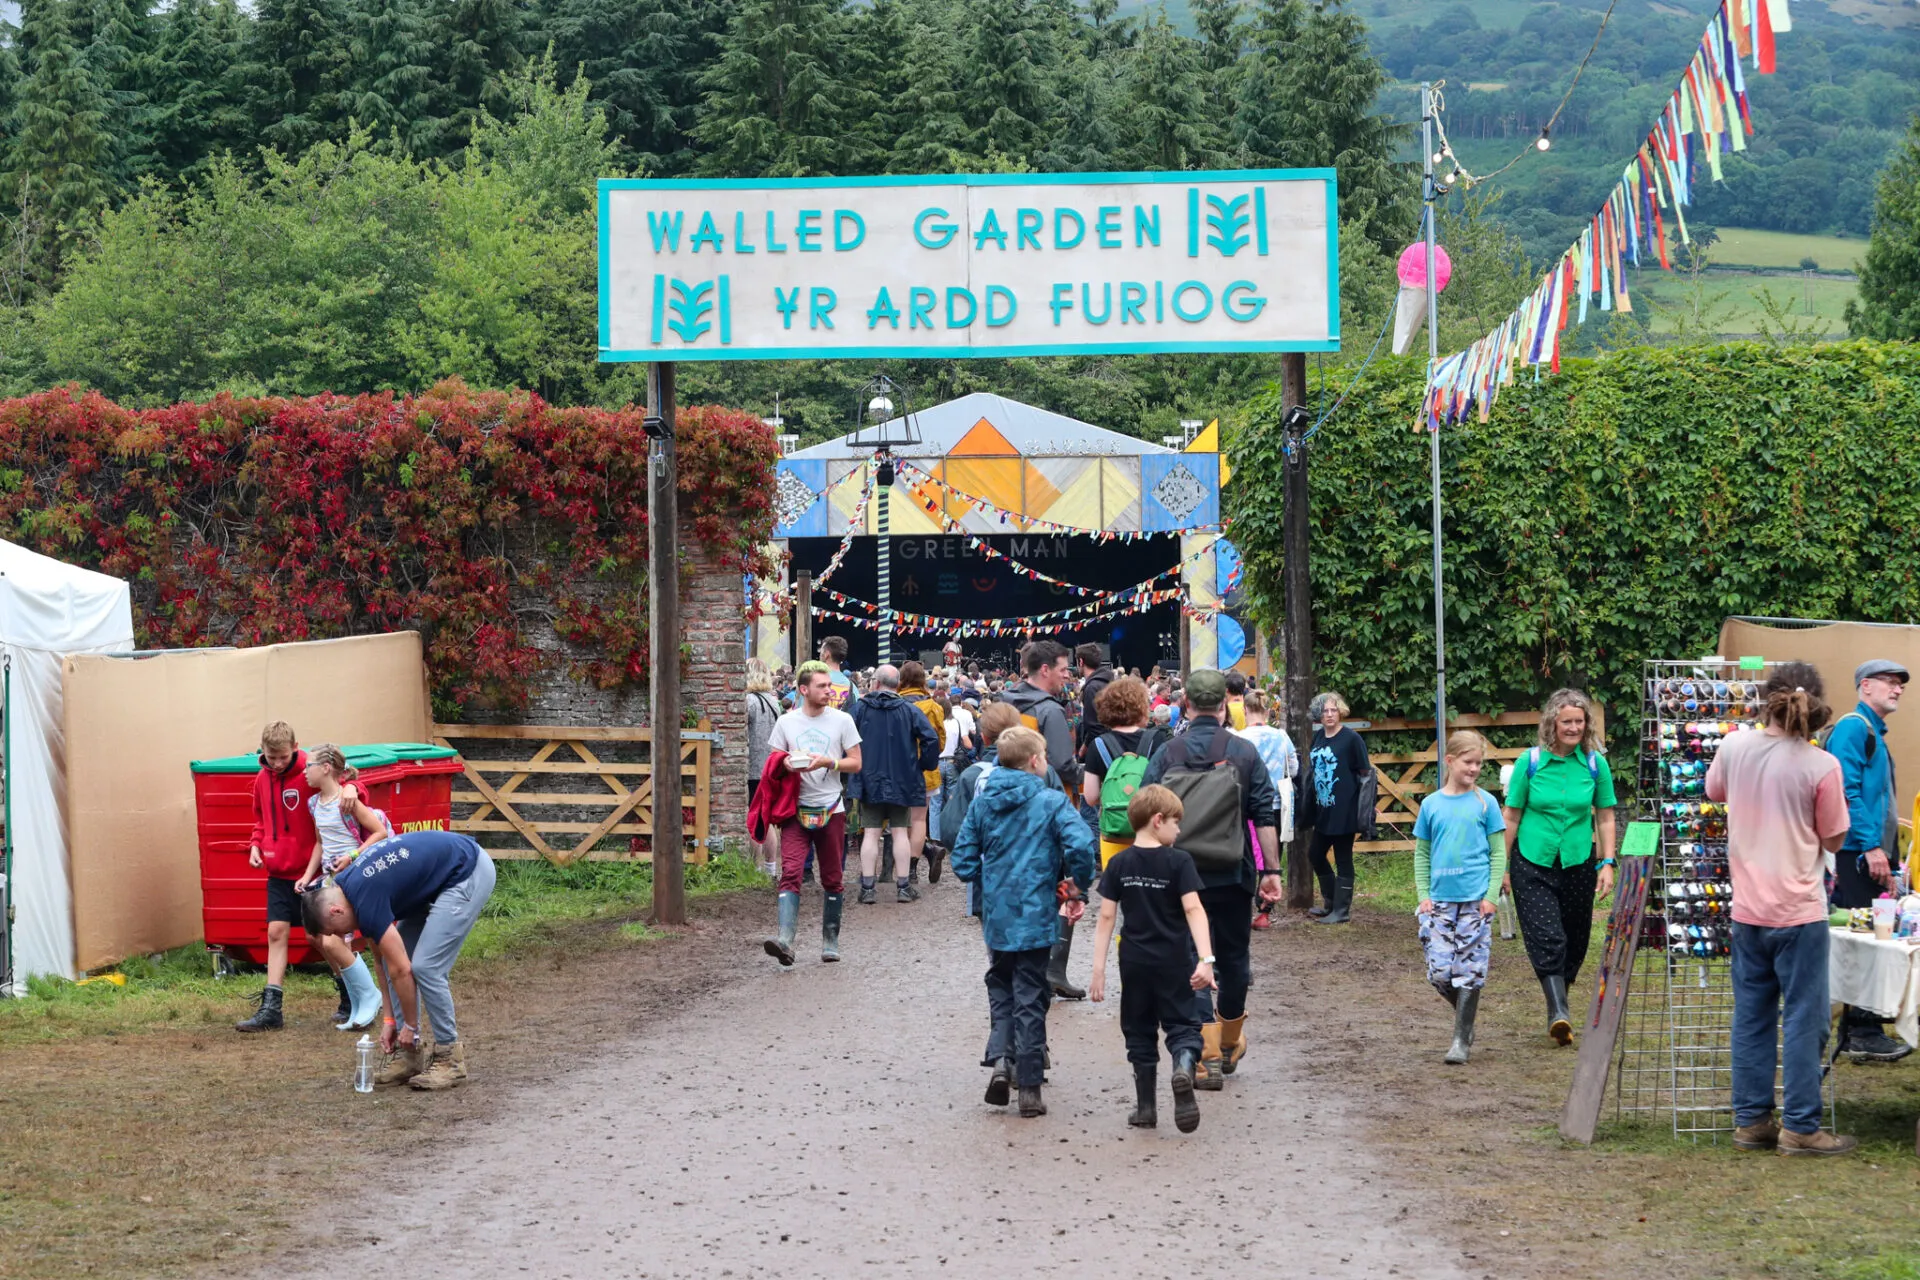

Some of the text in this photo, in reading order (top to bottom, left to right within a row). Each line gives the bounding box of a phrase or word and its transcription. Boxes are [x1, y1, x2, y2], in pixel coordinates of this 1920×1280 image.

[647, 204, 1161, 253] WALLED GARDEN
[774, 280, 1267, 330] YR ARDD FURIOG
[1010, 538, 1068, 559] MAN
[402, 818, 444, 834] THOMAS
